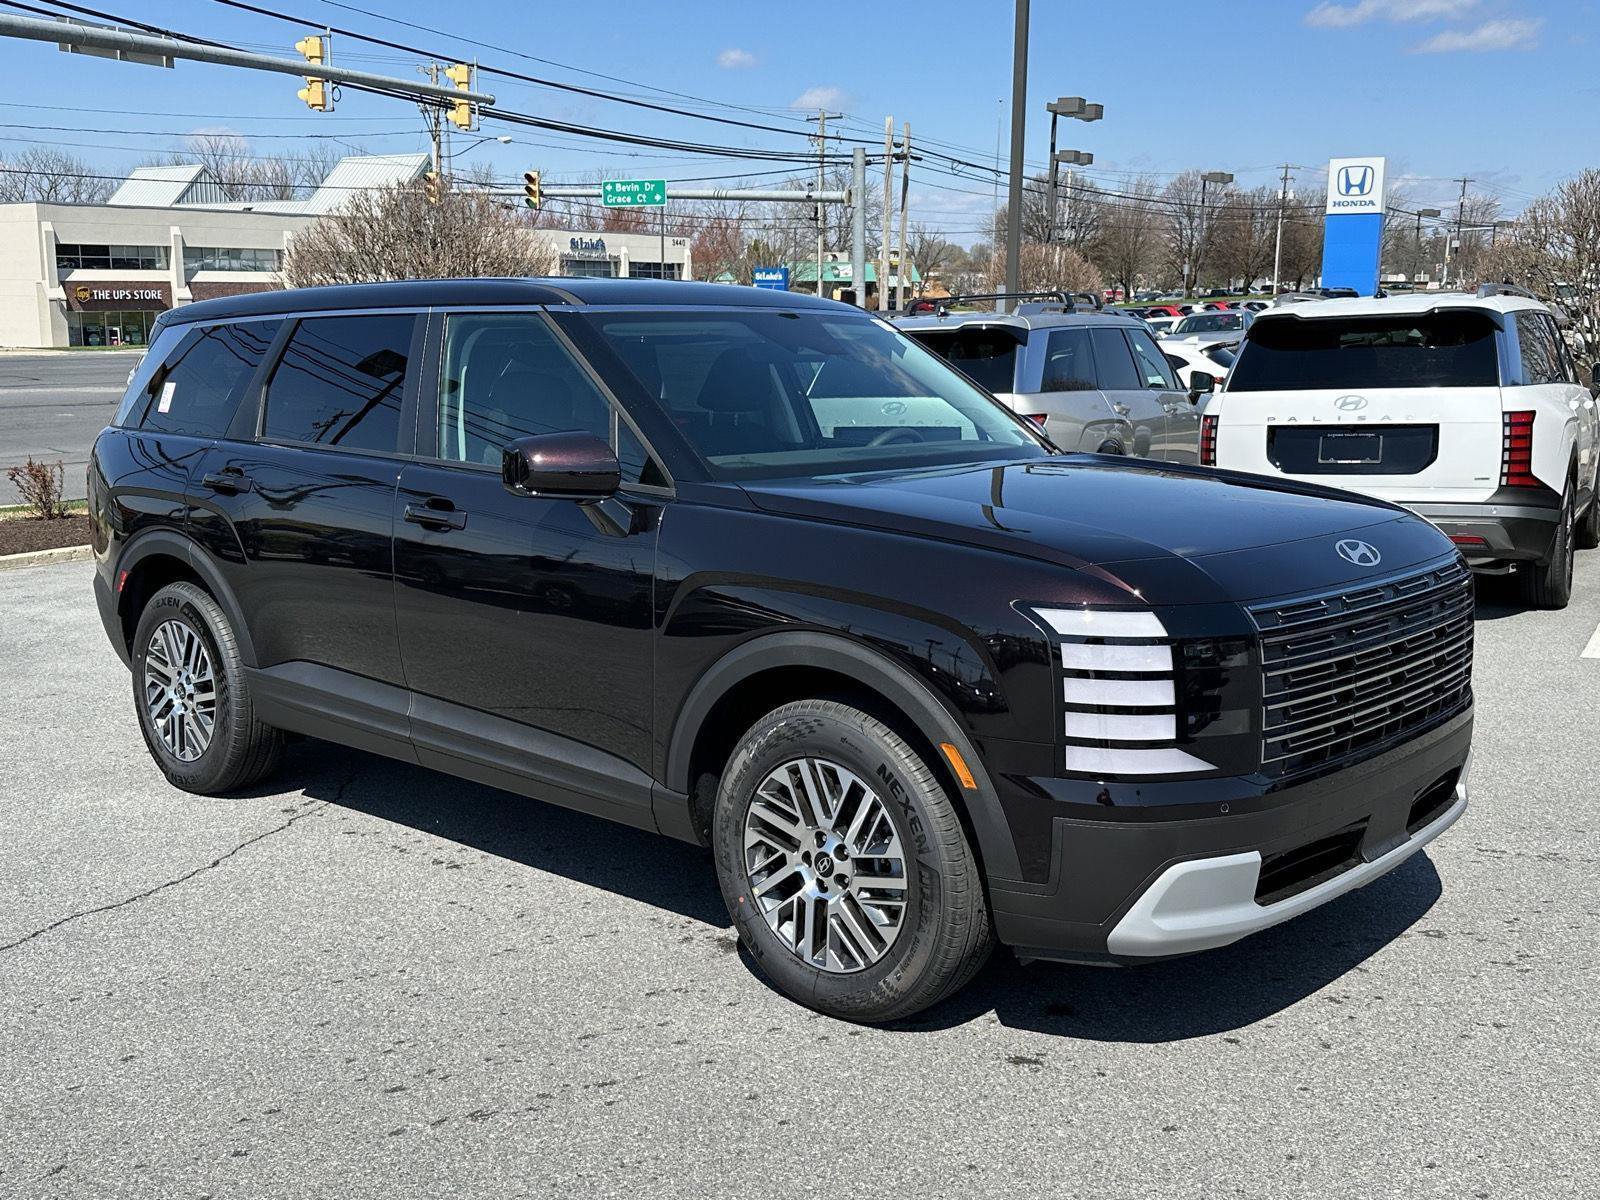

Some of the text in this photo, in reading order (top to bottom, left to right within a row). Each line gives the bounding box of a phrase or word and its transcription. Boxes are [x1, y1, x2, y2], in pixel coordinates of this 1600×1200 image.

[615, 182, 655, 192] Bevin Dr
[607, 193, 647, 203] Grace Ct
[1332, 200, 1376, 208] HONDA
[671, 239, 686, 247] 3440
[92, 289, 163, 300] THE UPS STORE
[875, 762, 930, 855] NEXEN
